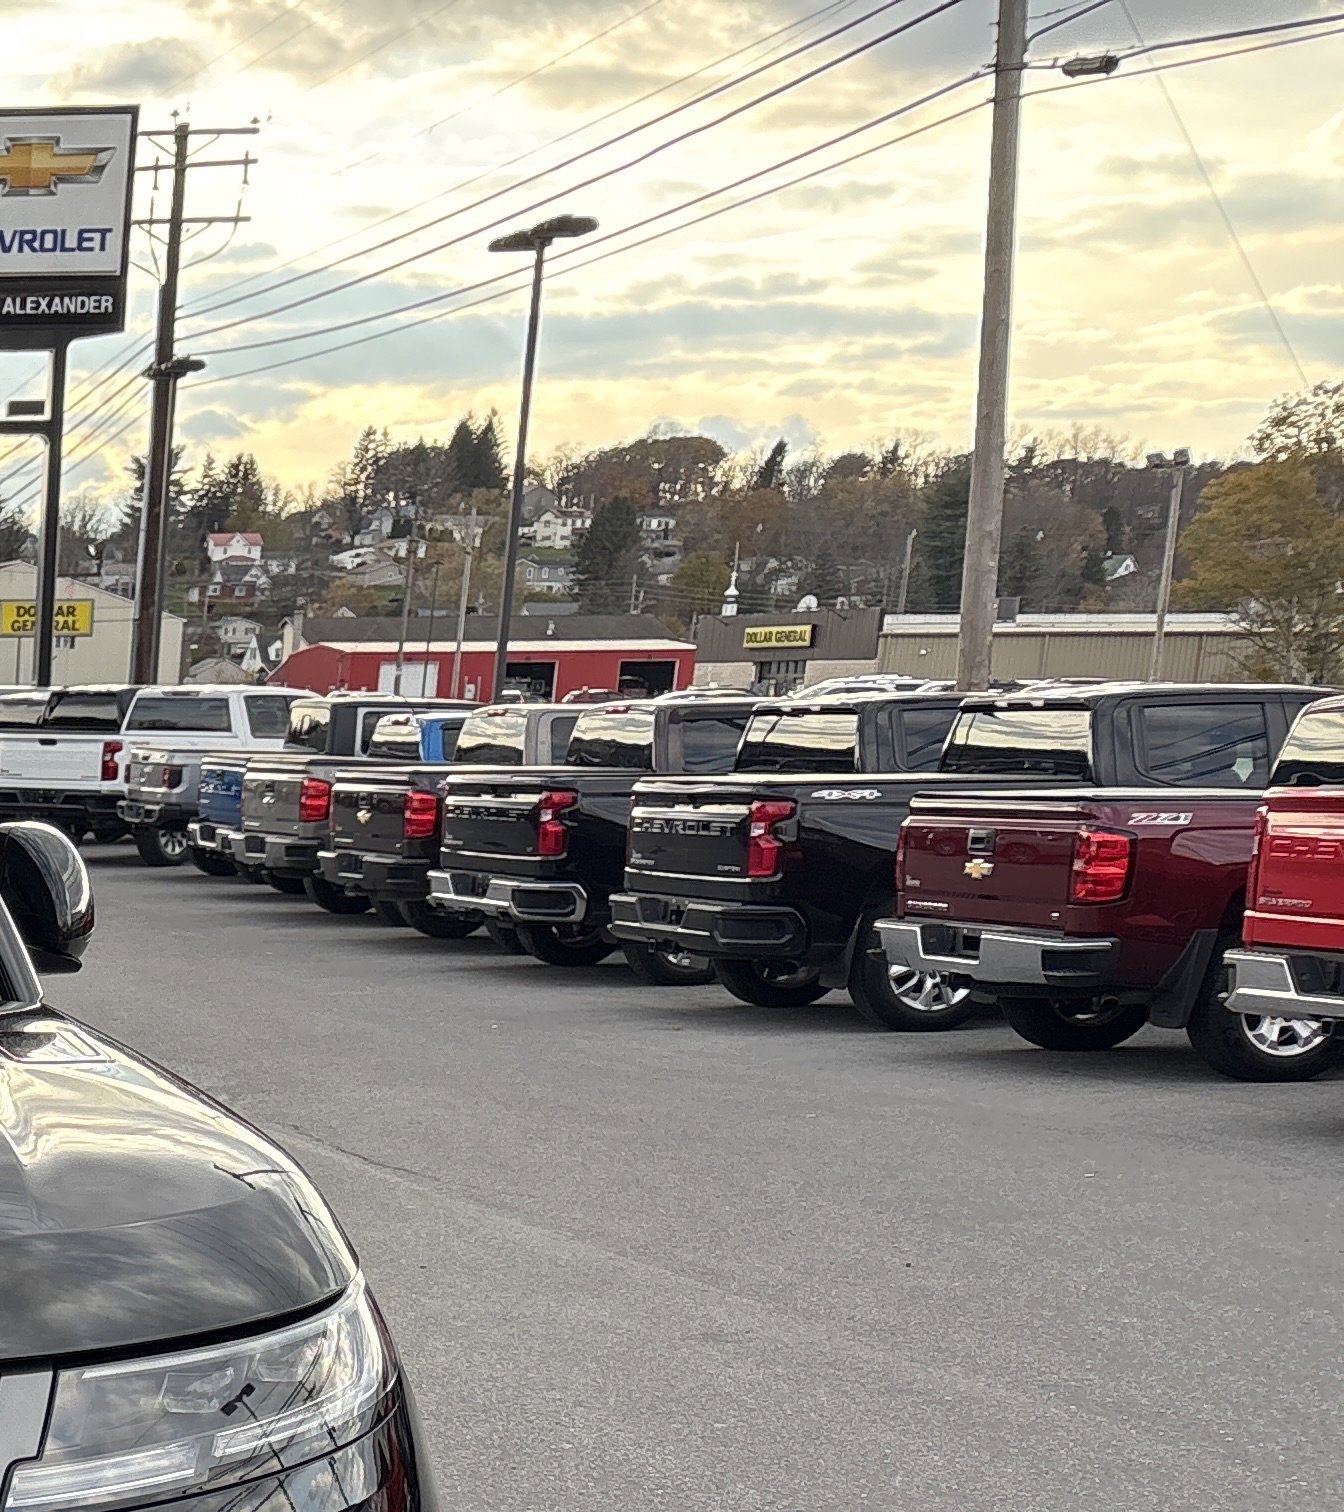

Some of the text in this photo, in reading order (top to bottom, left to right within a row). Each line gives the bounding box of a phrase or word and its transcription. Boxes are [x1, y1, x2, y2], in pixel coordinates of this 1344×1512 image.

[2, 296, 114, 315] ALEXANDER
[15, 605, 78, 618] DOAR
[10, 619, 81, 633] GERAL
[1127, 812, 1194, 826] Z71
[632, 818, 737, 837] CHEVROLET
